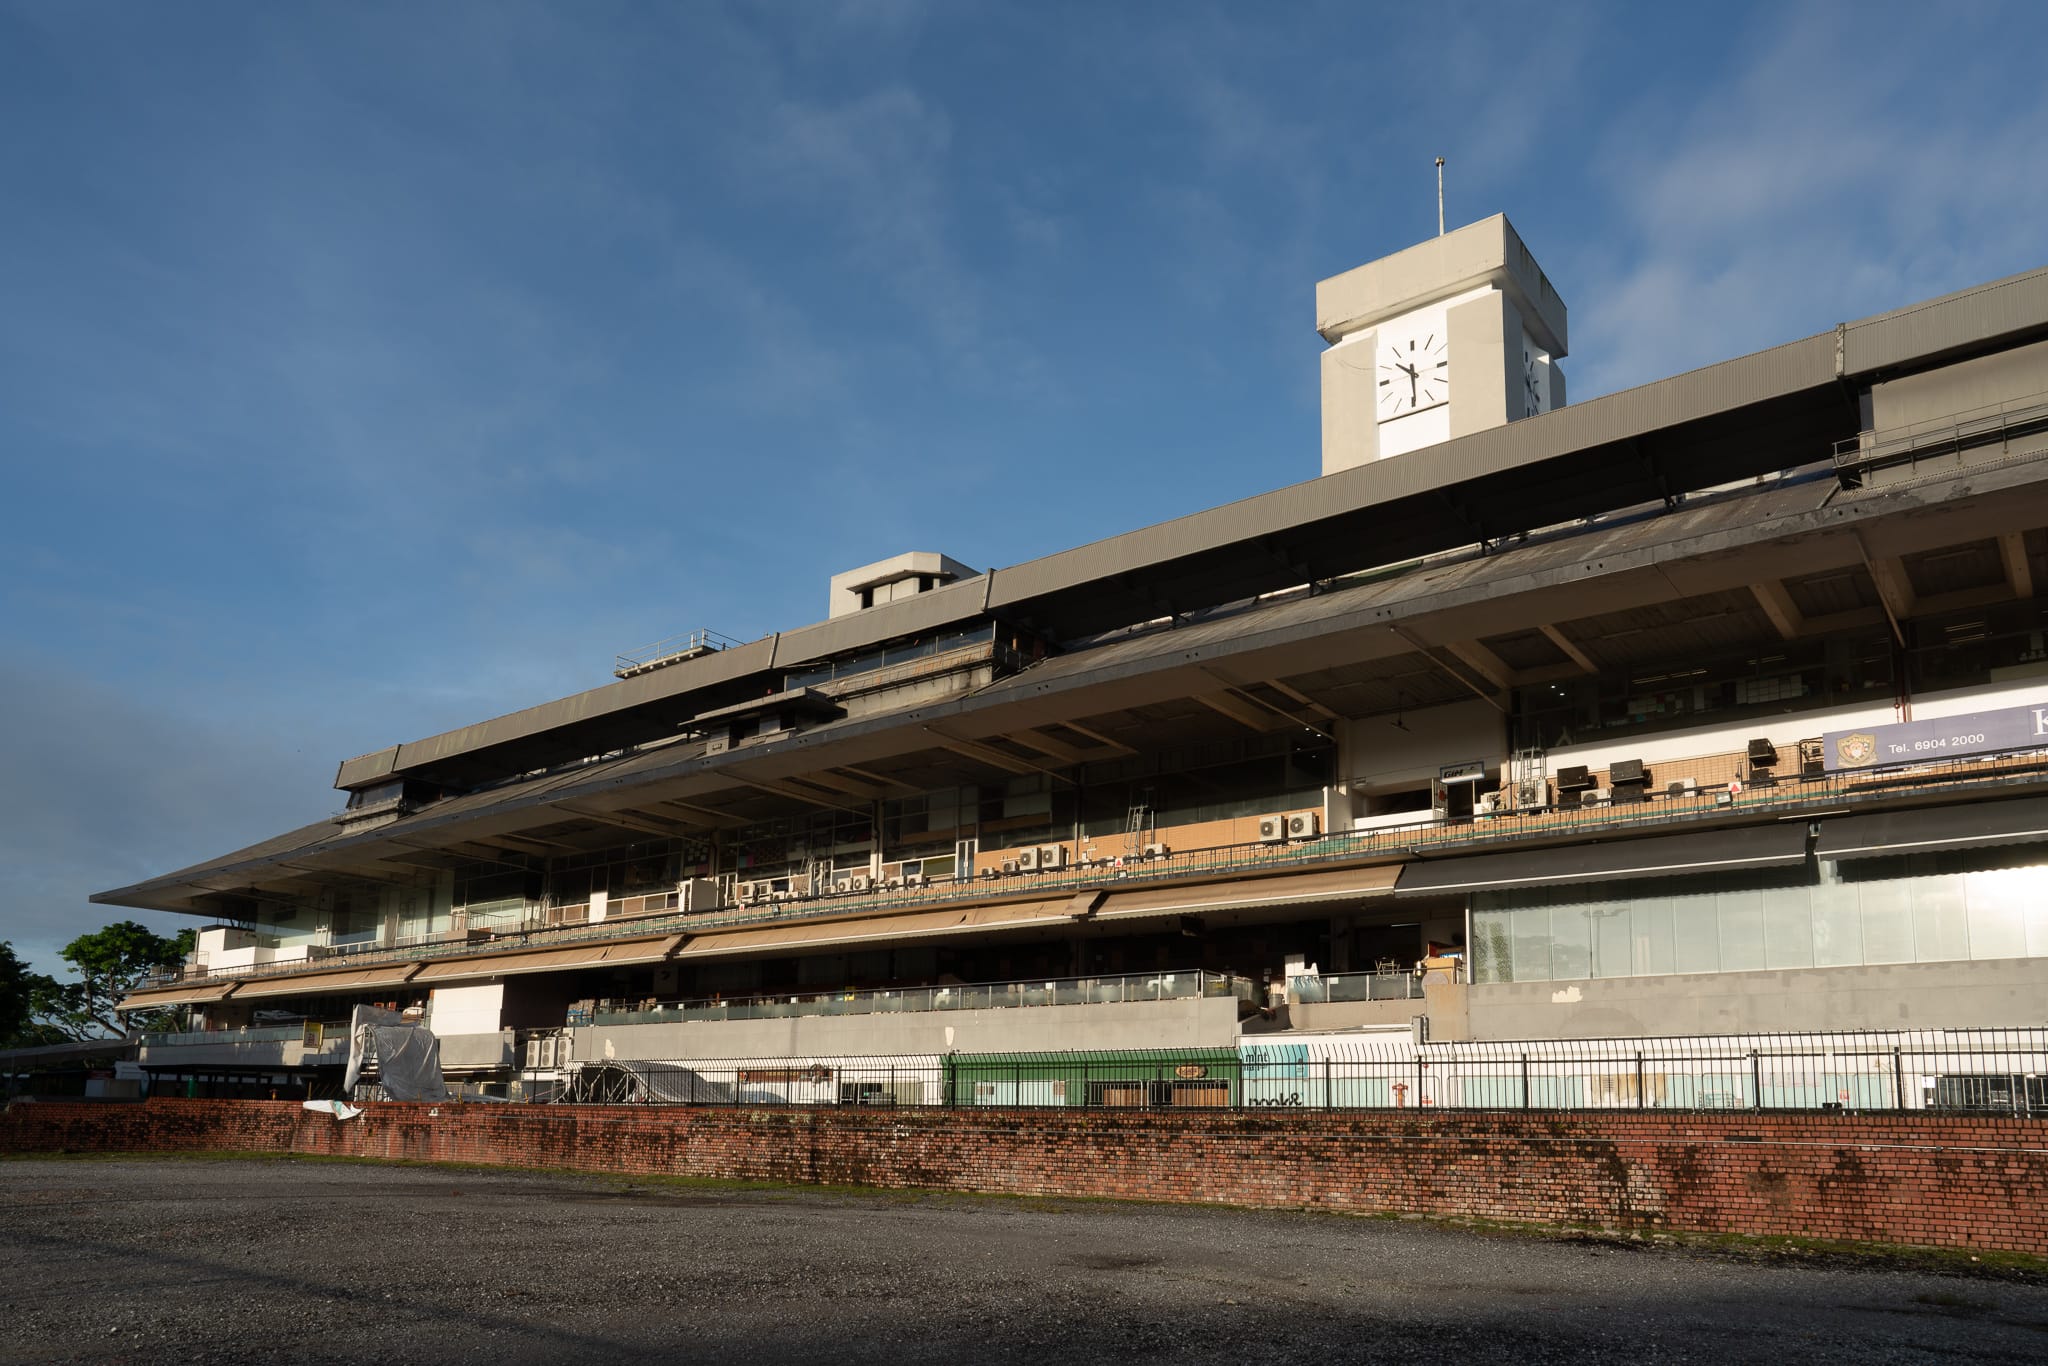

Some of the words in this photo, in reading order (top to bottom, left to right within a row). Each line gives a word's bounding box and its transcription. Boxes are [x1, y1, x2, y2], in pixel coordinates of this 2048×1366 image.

[1888, 743, 1911, 754] Tel.
[1915, 738, 1946, 751] 6904
[1952, 733, 1985, 746] 2000
